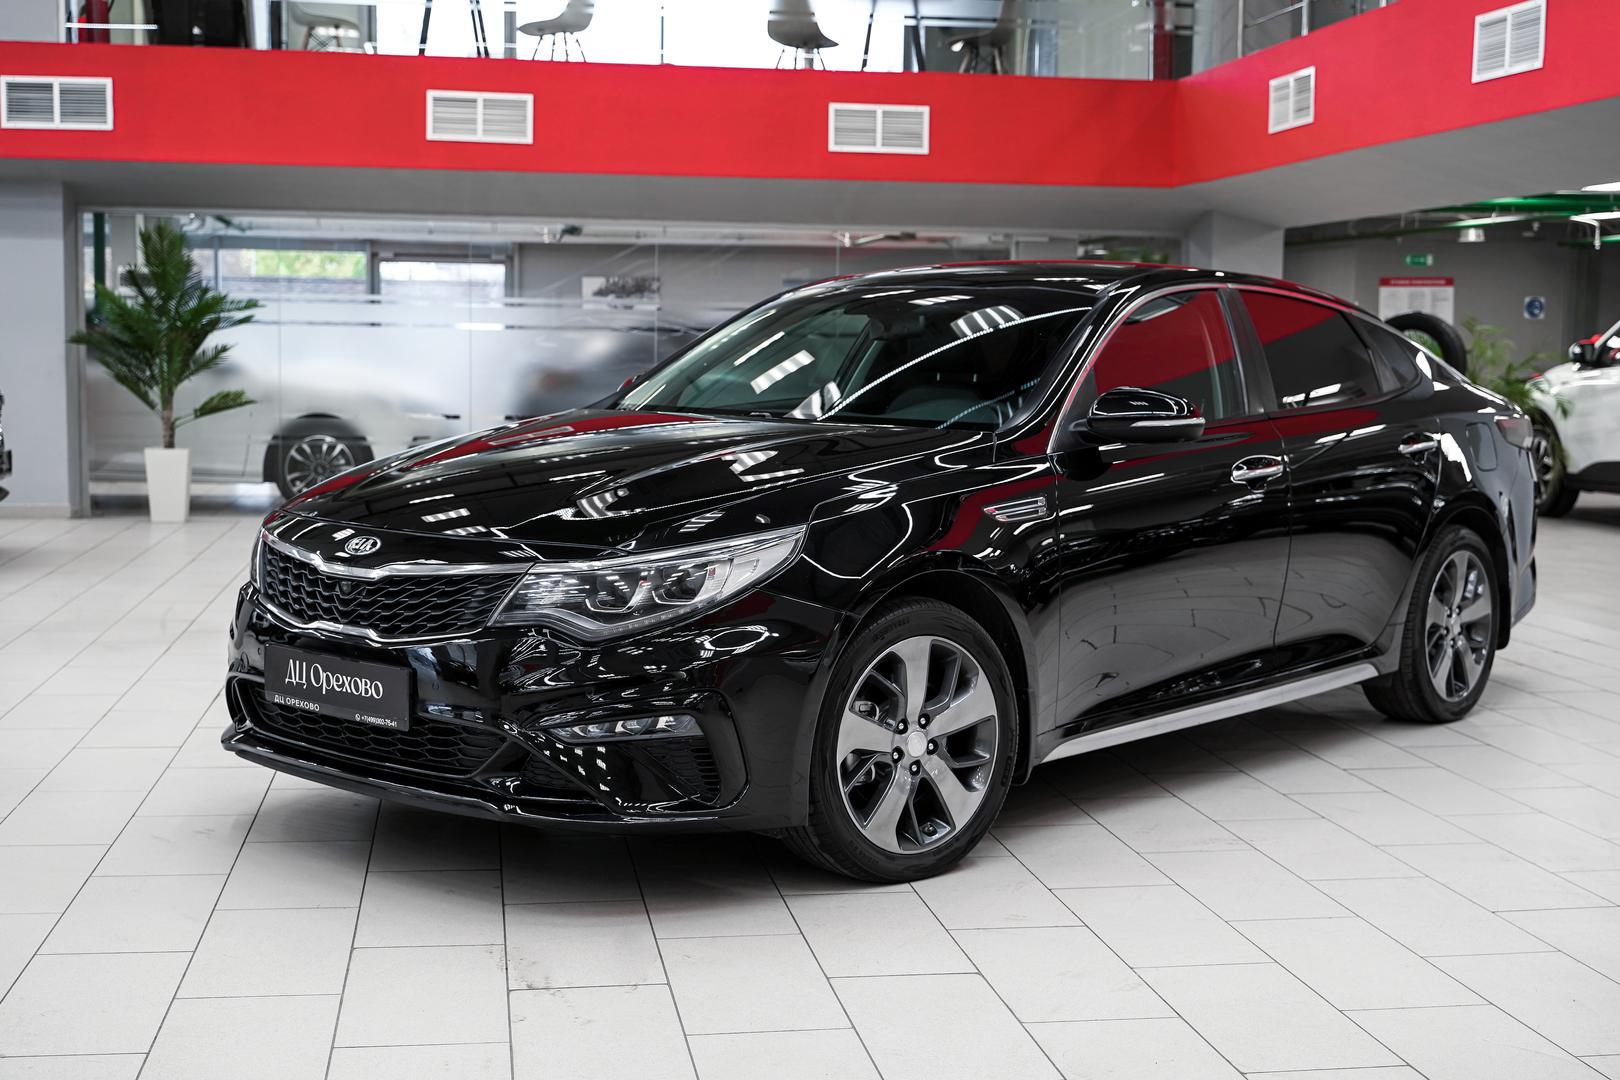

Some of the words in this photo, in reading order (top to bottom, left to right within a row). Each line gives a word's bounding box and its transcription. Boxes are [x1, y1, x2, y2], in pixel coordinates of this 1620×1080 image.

[346, 537, 376, 553] KIA
[285, 658, 307, 689] ДЦ
[310, 663, 384, 699] Орехово
[274, 694, 285, 705] ДЦ
[285, 697, 320, 712] ОРЕХОВО
